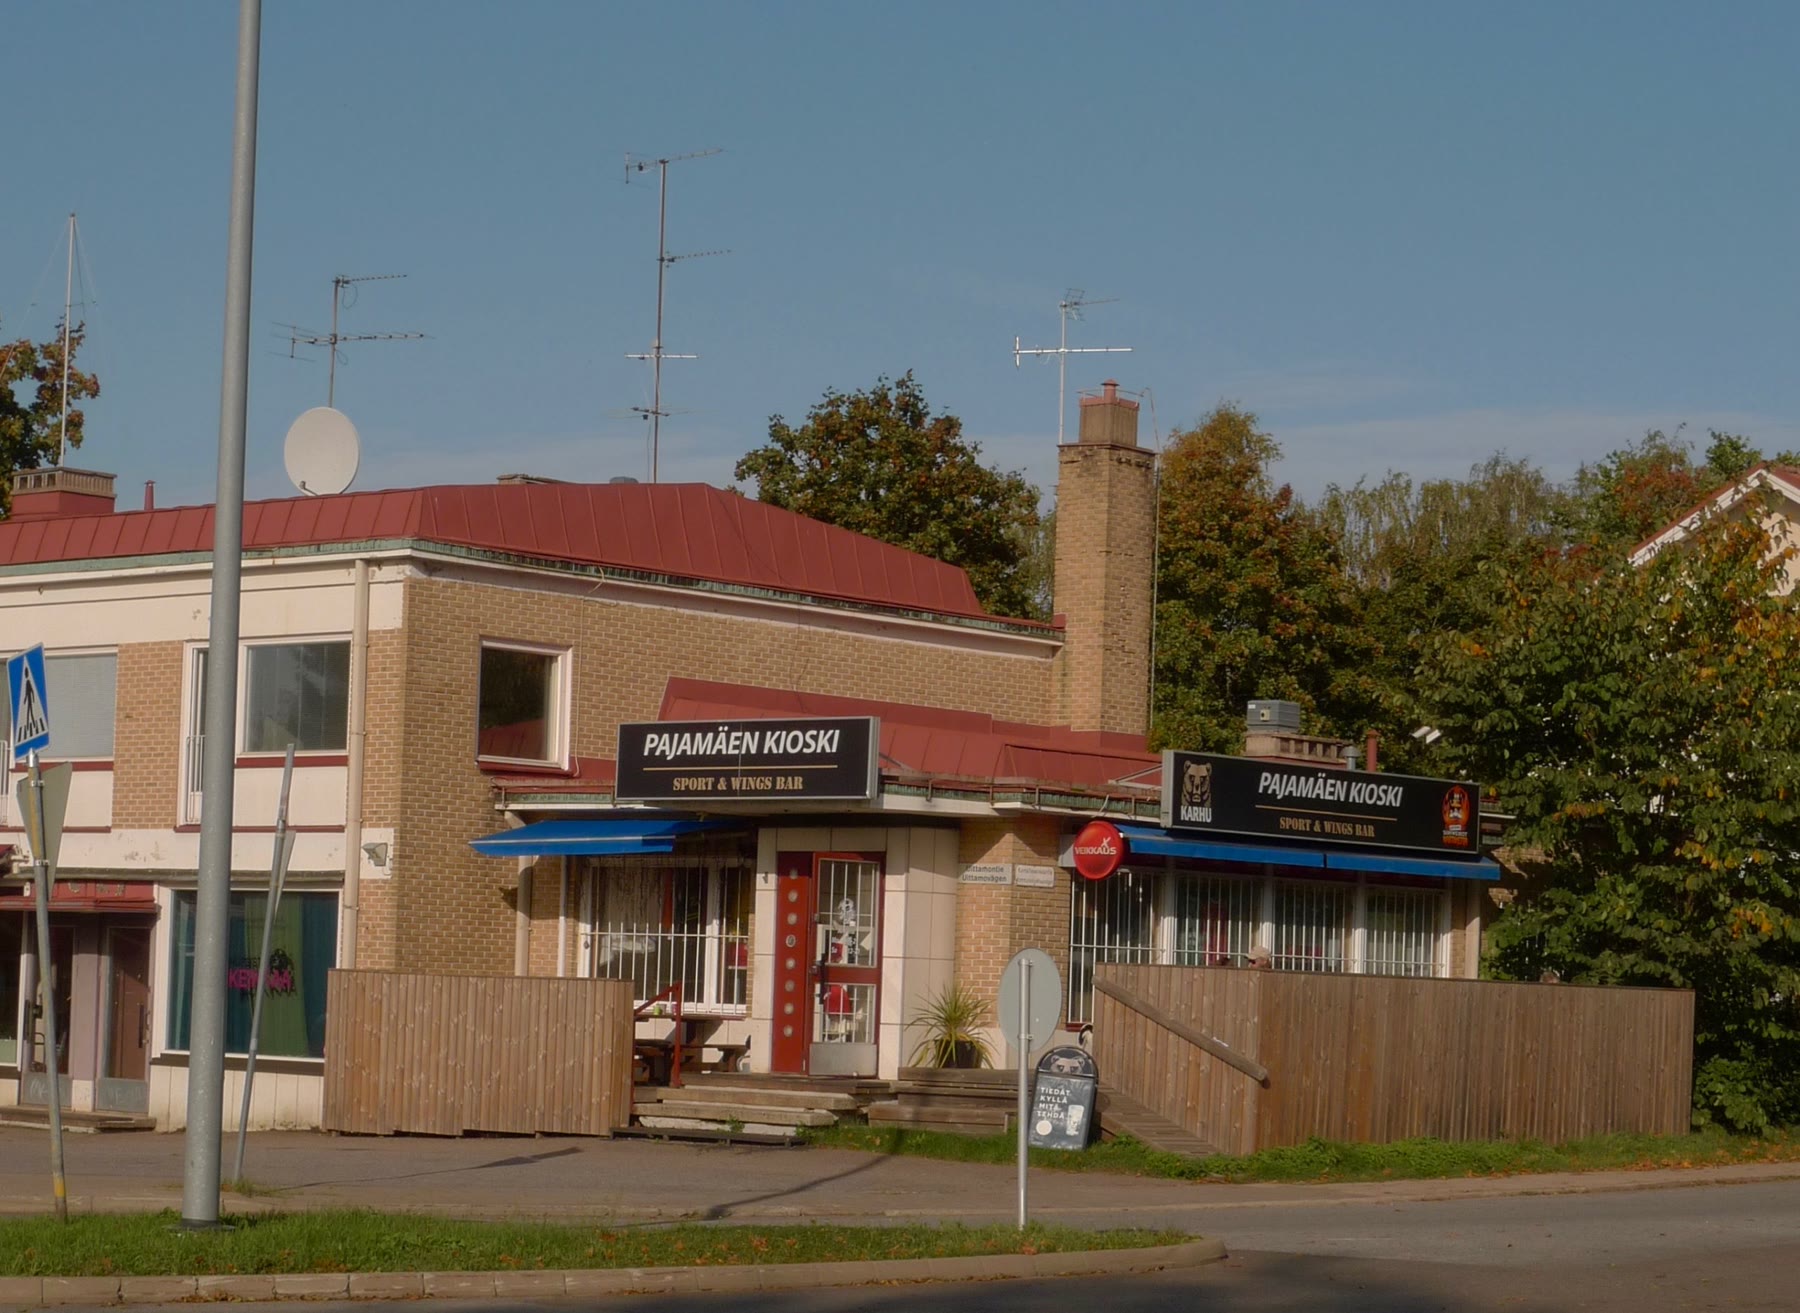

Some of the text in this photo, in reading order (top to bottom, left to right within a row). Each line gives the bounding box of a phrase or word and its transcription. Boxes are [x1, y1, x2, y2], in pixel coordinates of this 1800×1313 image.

[643, 726, 840, 760] PAJAMÄEN KIOSKI
[673, 777, 803, 791] SPORT & WINGS BAR
[1258, 772, 1403, 807] PAJAMÄEN KIOSKI
[1180, 805, 1212, 823] KARHU
[1279, 817, 1375, 837] SPORT & WINGS BAR
[1074, 846, 1117, 855] VEIKKAUS
